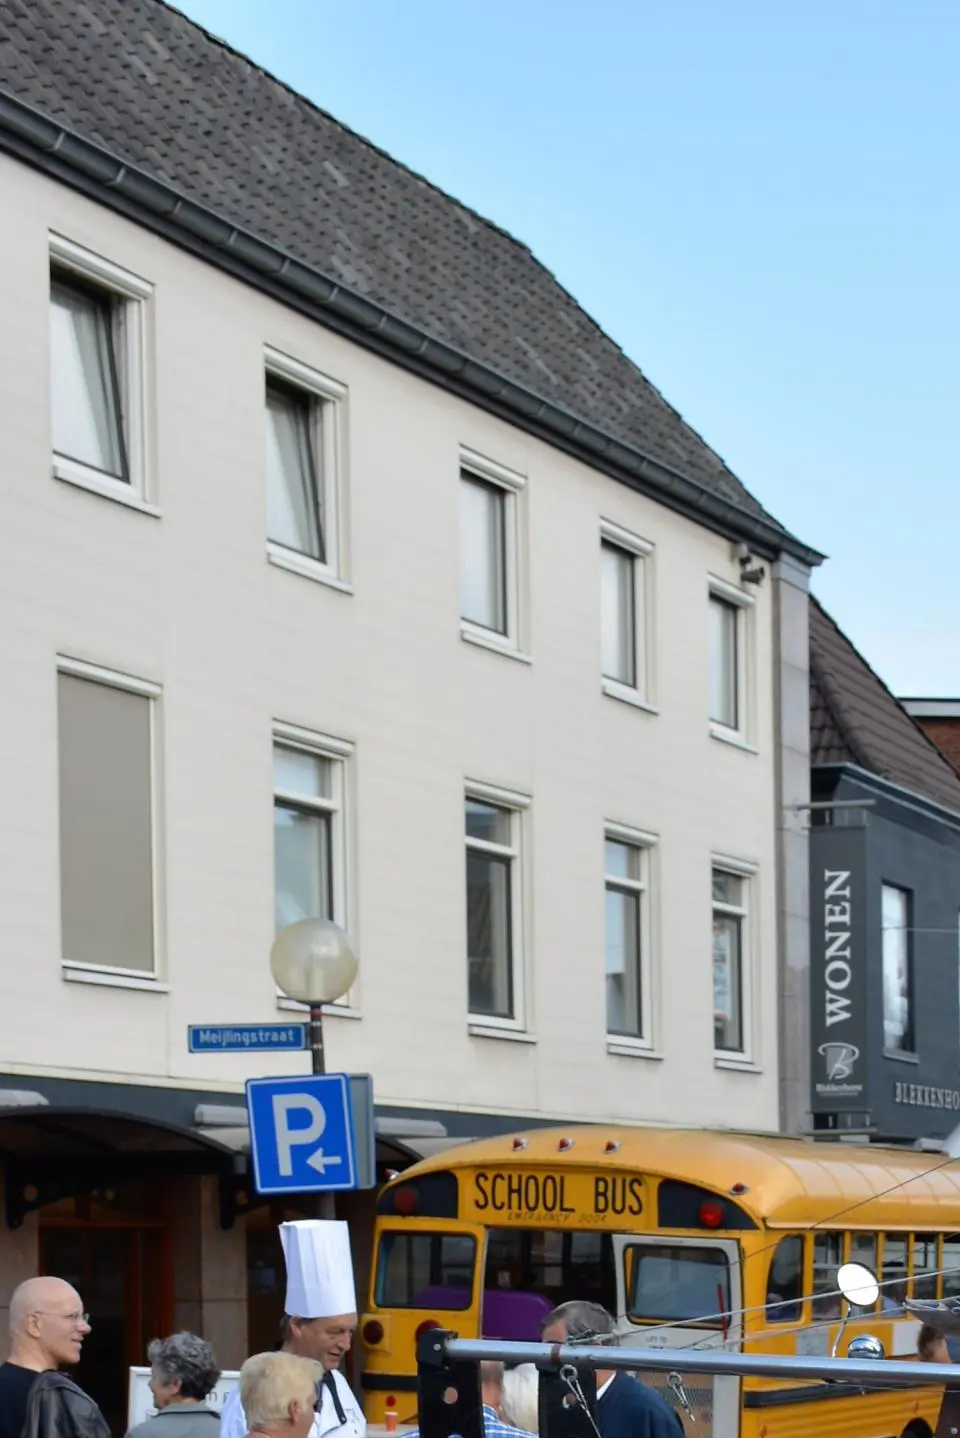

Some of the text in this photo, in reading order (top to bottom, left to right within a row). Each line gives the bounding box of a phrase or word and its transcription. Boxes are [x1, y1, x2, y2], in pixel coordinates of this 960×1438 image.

[824, 868, 852, 1028] WONEN
[271, 1092, 327, 1177] P
[474, 1171, 644, 1216] SCHOOL BUS
